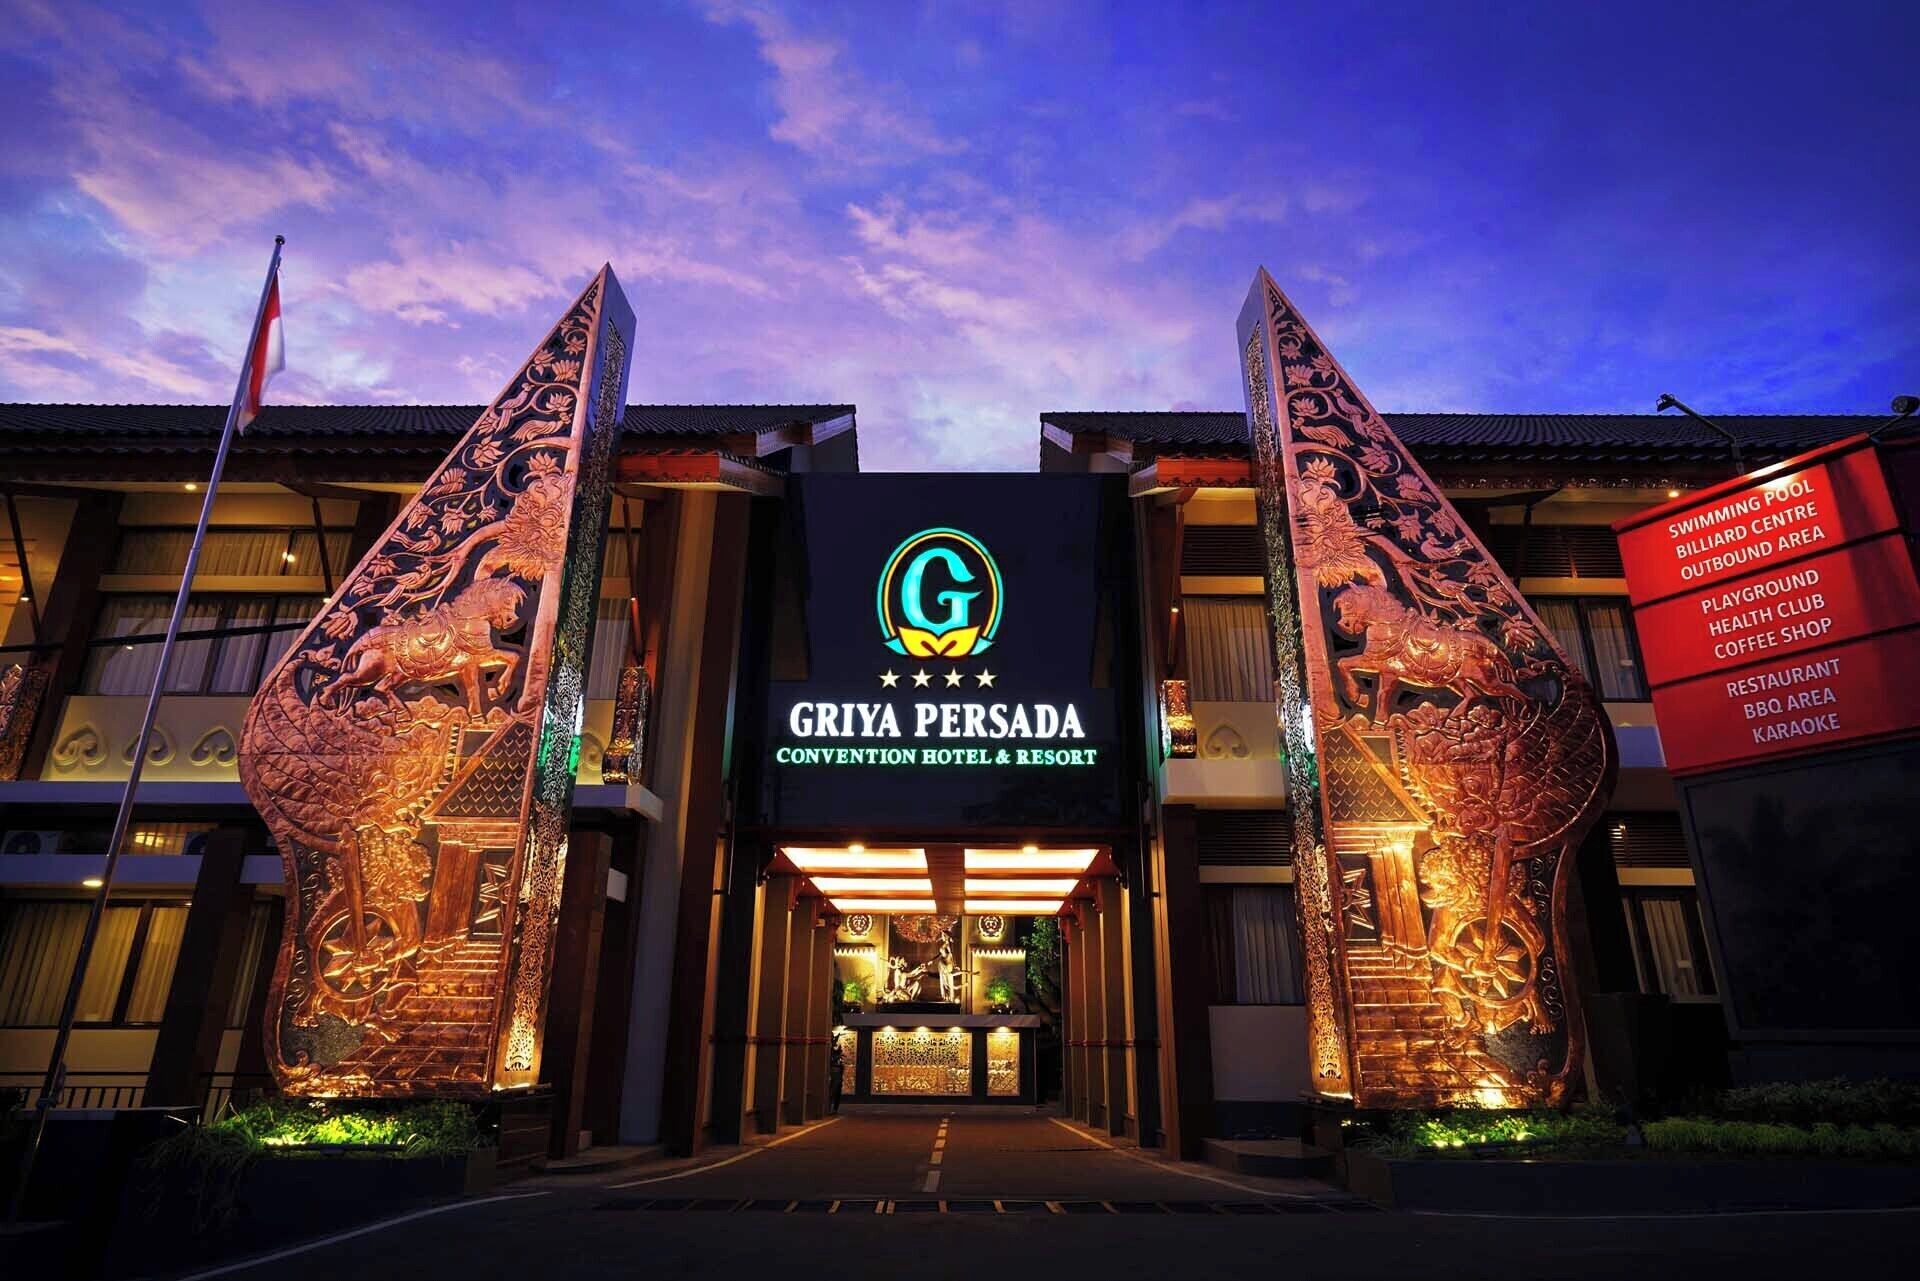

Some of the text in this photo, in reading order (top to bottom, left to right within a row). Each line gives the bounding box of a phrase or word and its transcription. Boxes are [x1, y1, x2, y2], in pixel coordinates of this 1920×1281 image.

[1668, 479, 1815, 538] SWIMMING POOL
[1675, 501, 1818, 560] BILLIARD CENTRE
[1680, 525, 1826, 580] OUTBOUND AREA
[901, 547, 983, 634] G
[1701, 569, 1820, 614] PLAYGROUND
[1709, 593, 1825, 637] HEALTH CLUB
[1714, 617, 1833, 659] COFFEE SHOP
[1727, 659, 1841, 698] RESTAURANT
[790, 702, 1086, 739] GRIYA PERSADA
[1744, 687, 1837, 719] BBQ AREA
[1753, 713, 1841, 744] KARAOKE
[776, 748, 1097, 765] CONVENTION HOTEL & RESORT
